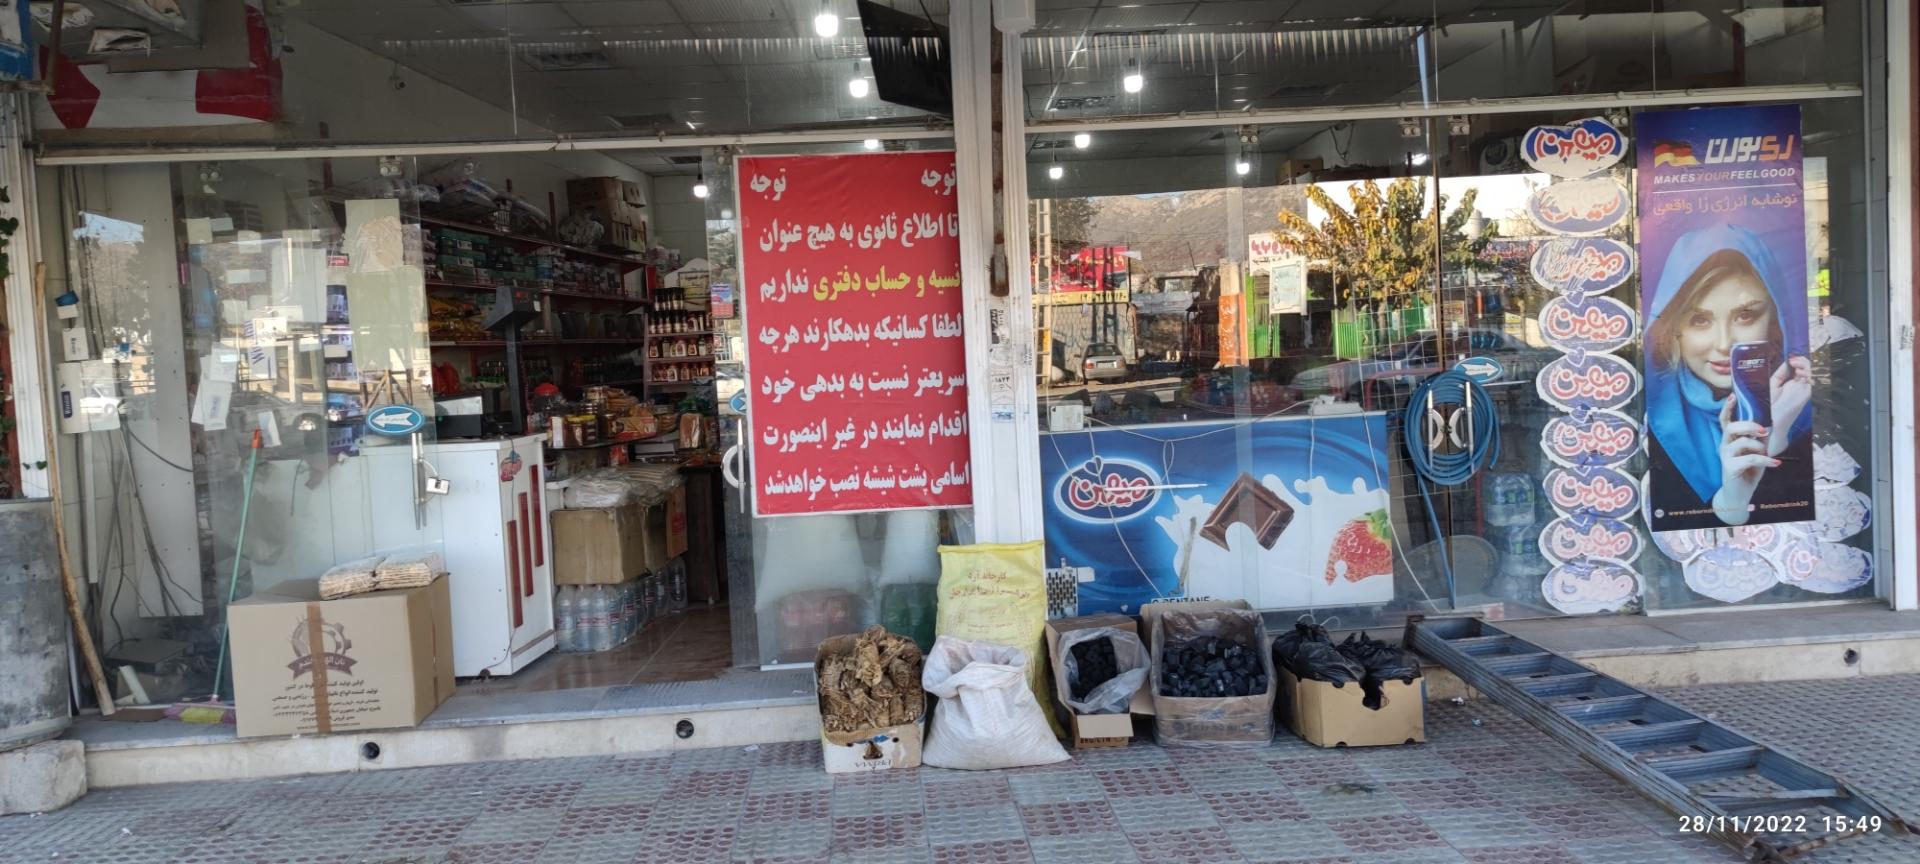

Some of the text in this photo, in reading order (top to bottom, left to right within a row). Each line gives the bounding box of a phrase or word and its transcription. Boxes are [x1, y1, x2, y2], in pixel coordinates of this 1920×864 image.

[750, 168, 787, 200] توجه
[921, 163, 956, 196] توجه
[1653, 197, 1693, 216] واقعی
[1752, 193, 1798, 209] نوشابه
[759, 212, 958, 252] تا اطلاع ثانوی به هیچ عنوان
[760, 262, 960, 302] نسیه و حساب دفتری نداریم
[759, 323, 799, 352] هرچه
[804, 317, 870, 351] بدهکارند
[873, 314, 928, 346] کسانیکه
[932, 313, 962, 339] لطفا
[1547, 304, 1628, 341] میهن
[761, 365, 965, 403] سریعتر نسبت به بدهی خود
[1550, 365, 1630, 400] میهن
[763, 411, 967, 453] اقدام نمایند در غیر اینصورت
[1553, 421, 1634, 456] میهن
[765, 461, 970, 501] اسامی پشت شیشه نصب خواهدشد
[1068, 473, 1151, 509] میهن
[1553, 471, 1633, 512] میهن
[1552, 523, 1633, 558] میهن
